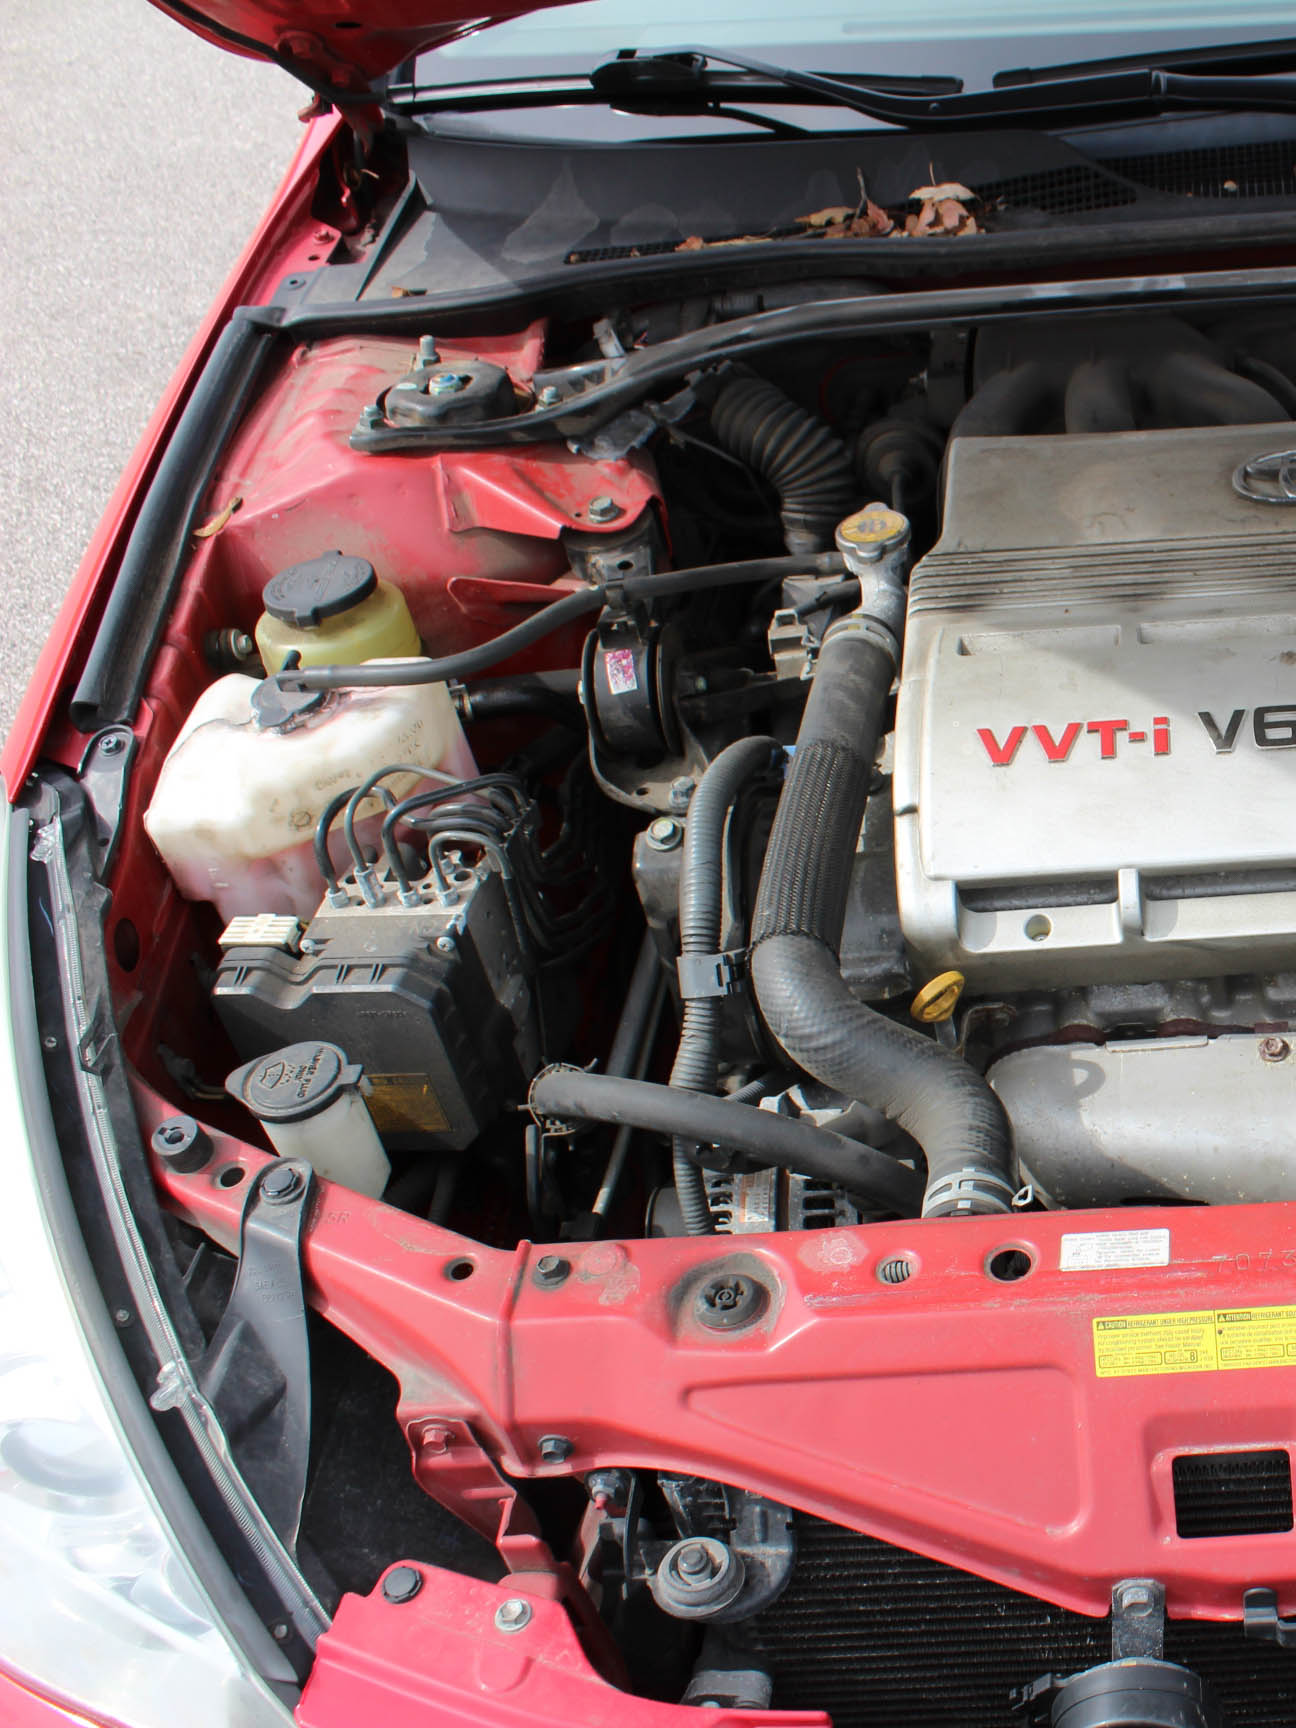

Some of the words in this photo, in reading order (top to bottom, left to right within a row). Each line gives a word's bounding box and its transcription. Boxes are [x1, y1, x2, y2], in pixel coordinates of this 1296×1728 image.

[976, 716, 1171, 767] VVT-i
[1252, 1310, 1284, 1319] REFRIGERANT
[1128, 1318, 1158, 1328] REFRIGERANT
[1189, 1315, 1213, 1324] PRESSURE
[1189, 1352, 1196, 1362] 8
